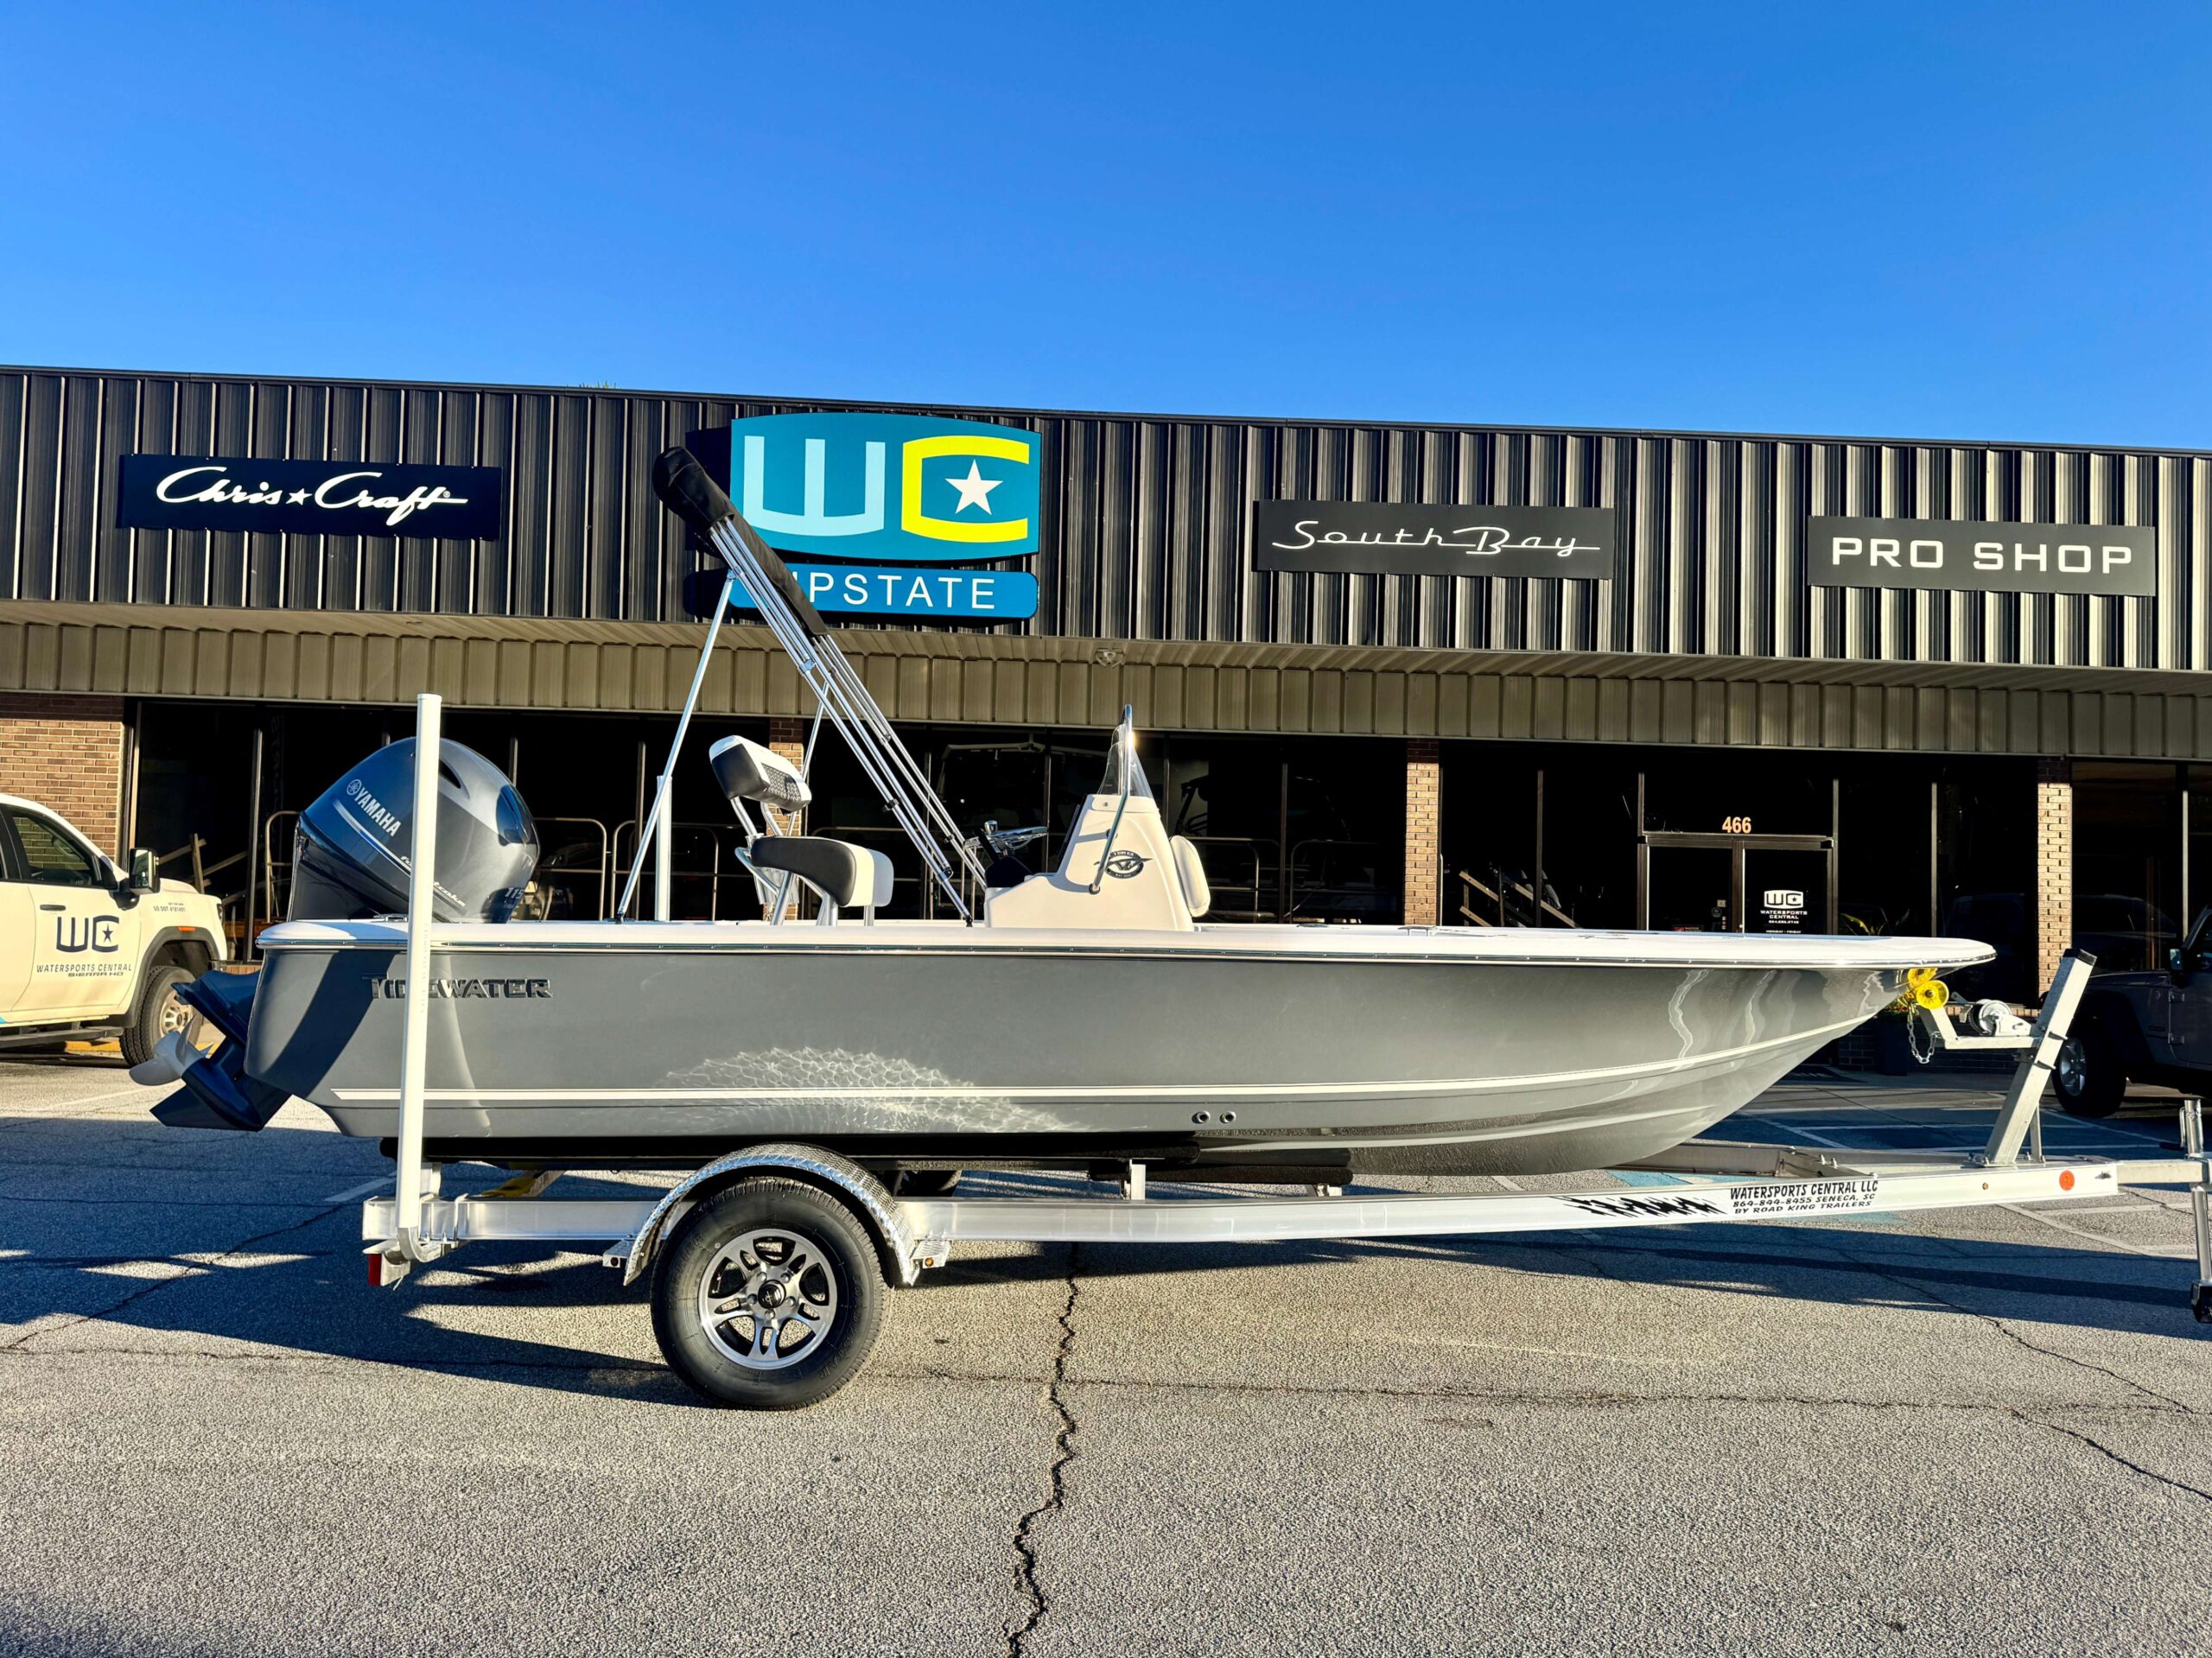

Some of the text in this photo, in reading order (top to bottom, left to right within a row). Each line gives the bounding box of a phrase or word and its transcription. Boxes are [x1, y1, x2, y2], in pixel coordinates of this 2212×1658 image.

[156, 466, 469, 526] Chris Craft
[743, 435, 1030, 543] WC
[1272, 520, 1599, 557] South Bay
[1832, 537, 2133, 575] PRO SHOP
[354, 786, 402, 837] YAMAHA
[1721, 816, 1752, 834] 466
[56, 914, 119, 953] WC
[36, 963, 132, 973] WATERSPORTS CENTRAL
[1730, 1180, 1878, 1200] WATERSPORTS CENTRAL LLC
[1732, 1197, 1812, 1208] 864-844-8455
[1820, 1201, 1872, 1210] TRAILERS
